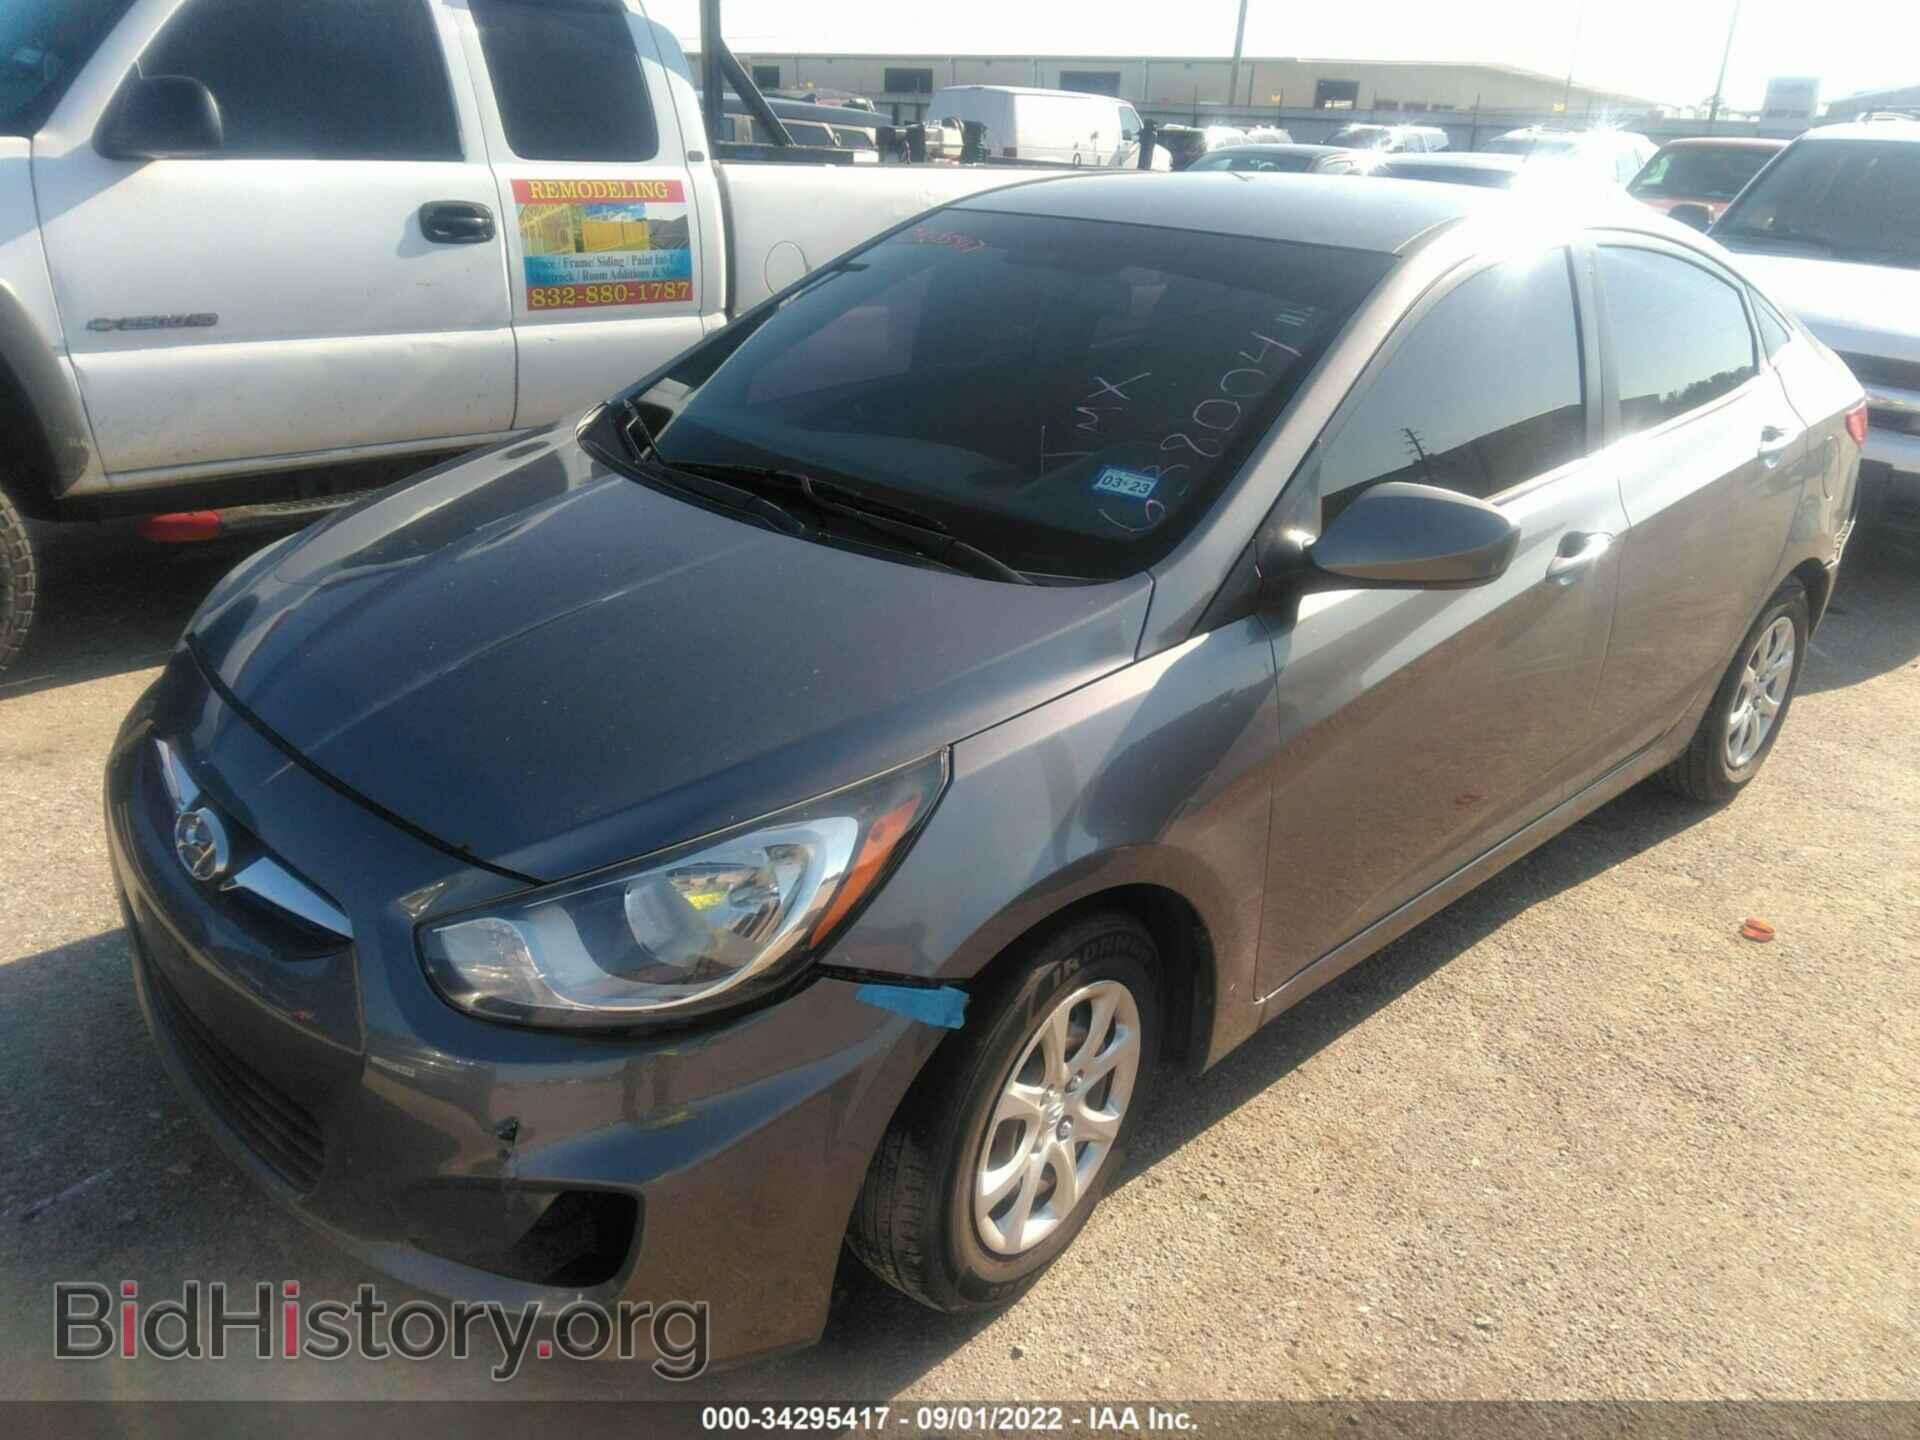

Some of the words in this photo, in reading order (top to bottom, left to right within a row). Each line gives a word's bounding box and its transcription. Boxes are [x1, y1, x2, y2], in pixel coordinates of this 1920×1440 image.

[528, 180, 669, 199] REMODELING
[597, 254, 625, 268] Siding
[531, 281, 690, 308] 832-880-1787
